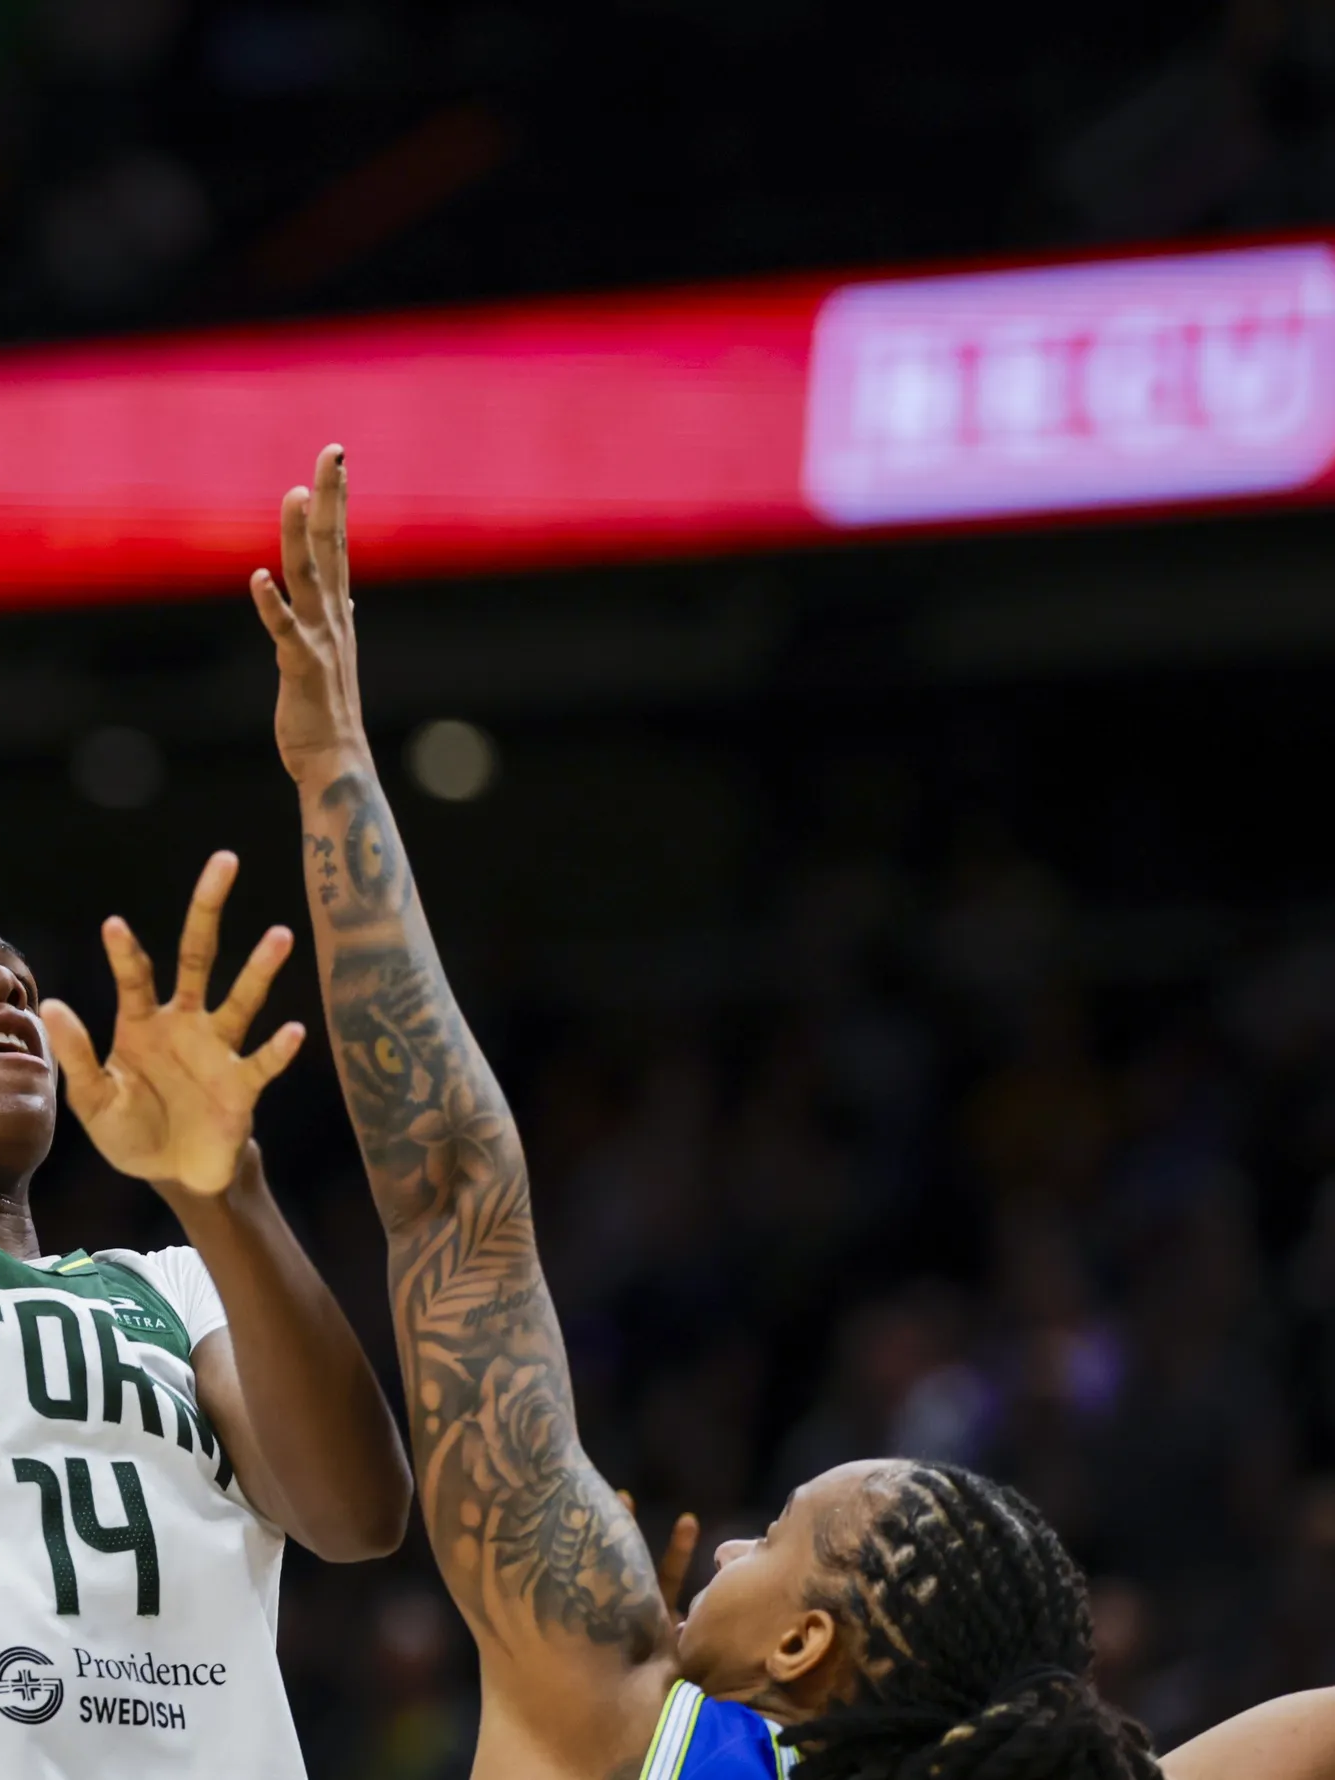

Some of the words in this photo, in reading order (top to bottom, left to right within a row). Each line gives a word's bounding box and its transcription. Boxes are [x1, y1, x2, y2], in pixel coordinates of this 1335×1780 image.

[12, 1457, 160, 1616] 14
[73, 1648, 226, 1686] Providence
[79, 1696, 186, 1730] SWEDISH
